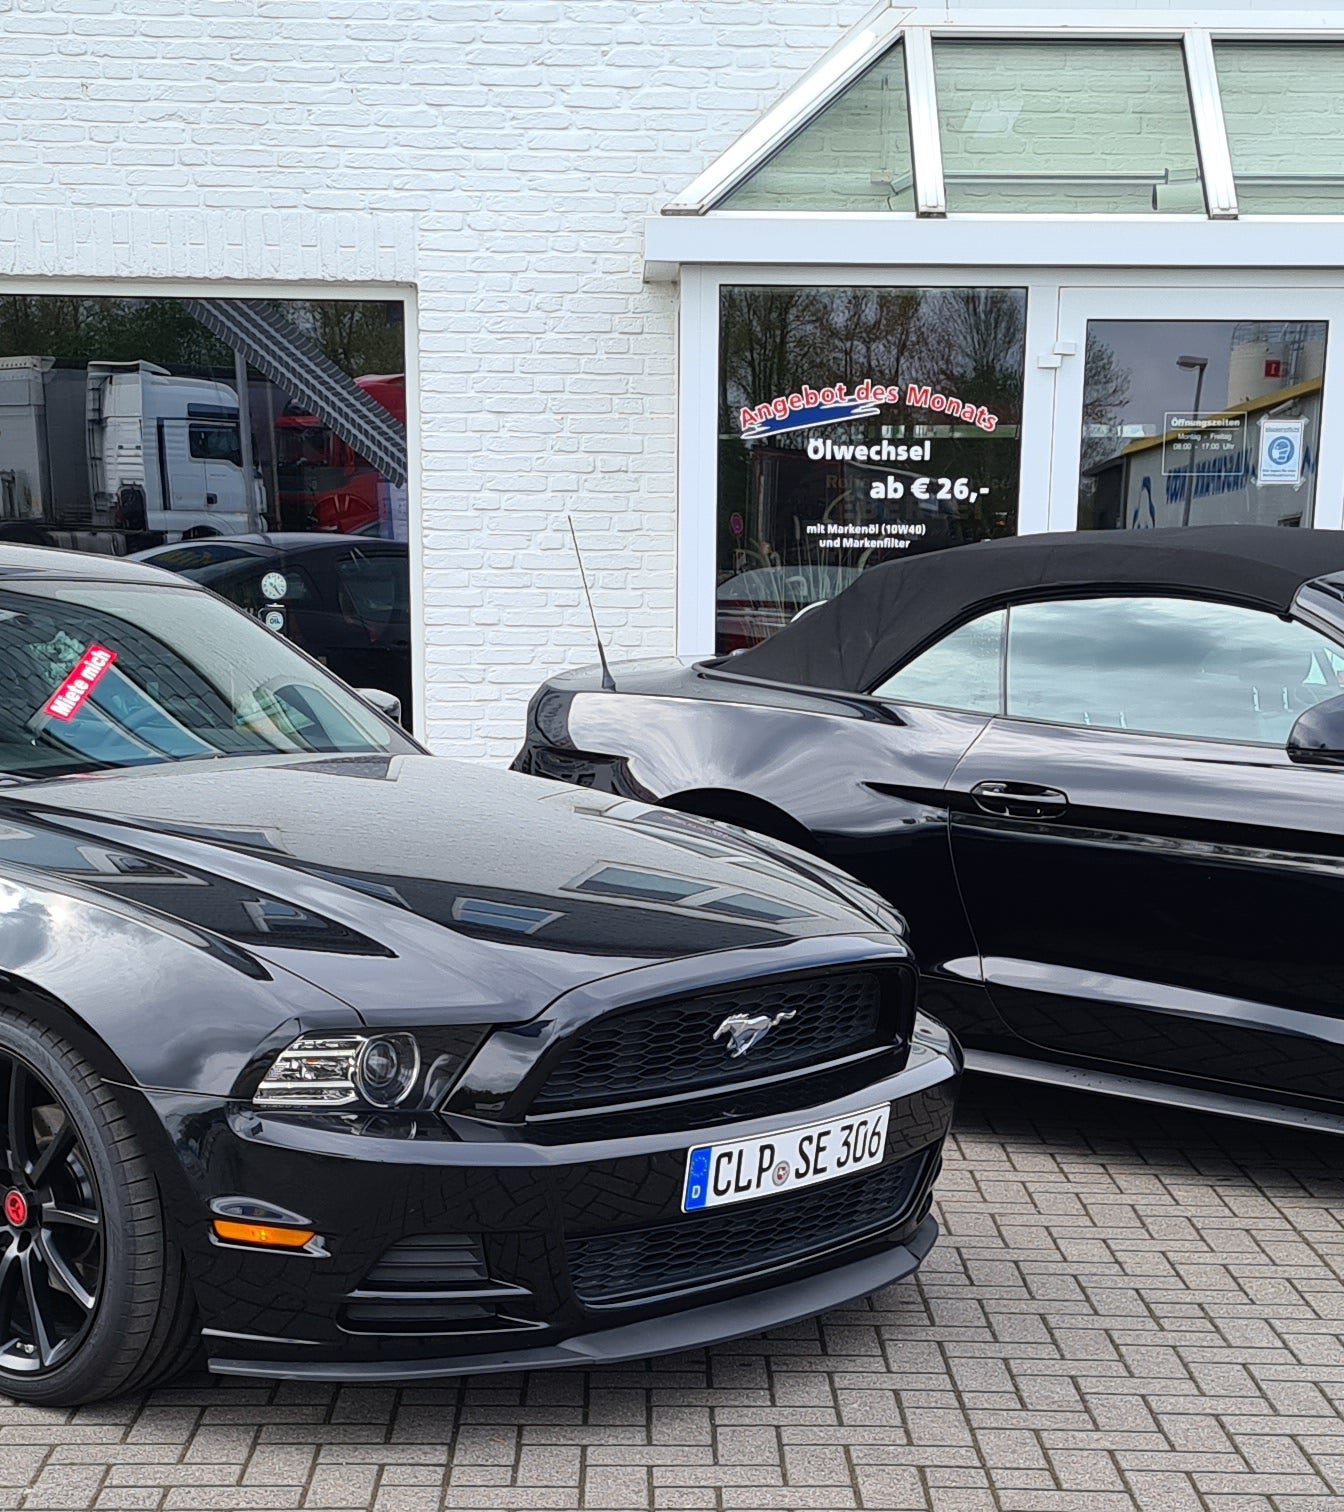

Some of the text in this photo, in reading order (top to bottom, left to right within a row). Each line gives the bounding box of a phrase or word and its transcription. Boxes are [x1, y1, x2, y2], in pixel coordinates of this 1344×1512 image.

[739, 379, 999, 432] Angebot des Monats
[1171, 416, 1240, 429] Öffnungszeiten
[807, 438, 931, 462] Ölwechsel
[869, 475, 904, 500] ab
[910, 478, 930, 500] €
[807, 522, 926, 536] mit Markenöl (10W40)
[819, 537, 911, 549] und Markenfilter
[49, 650, 111, 717] Miete mich
[692, 1115, 883, 1199] D CLP SE 306
